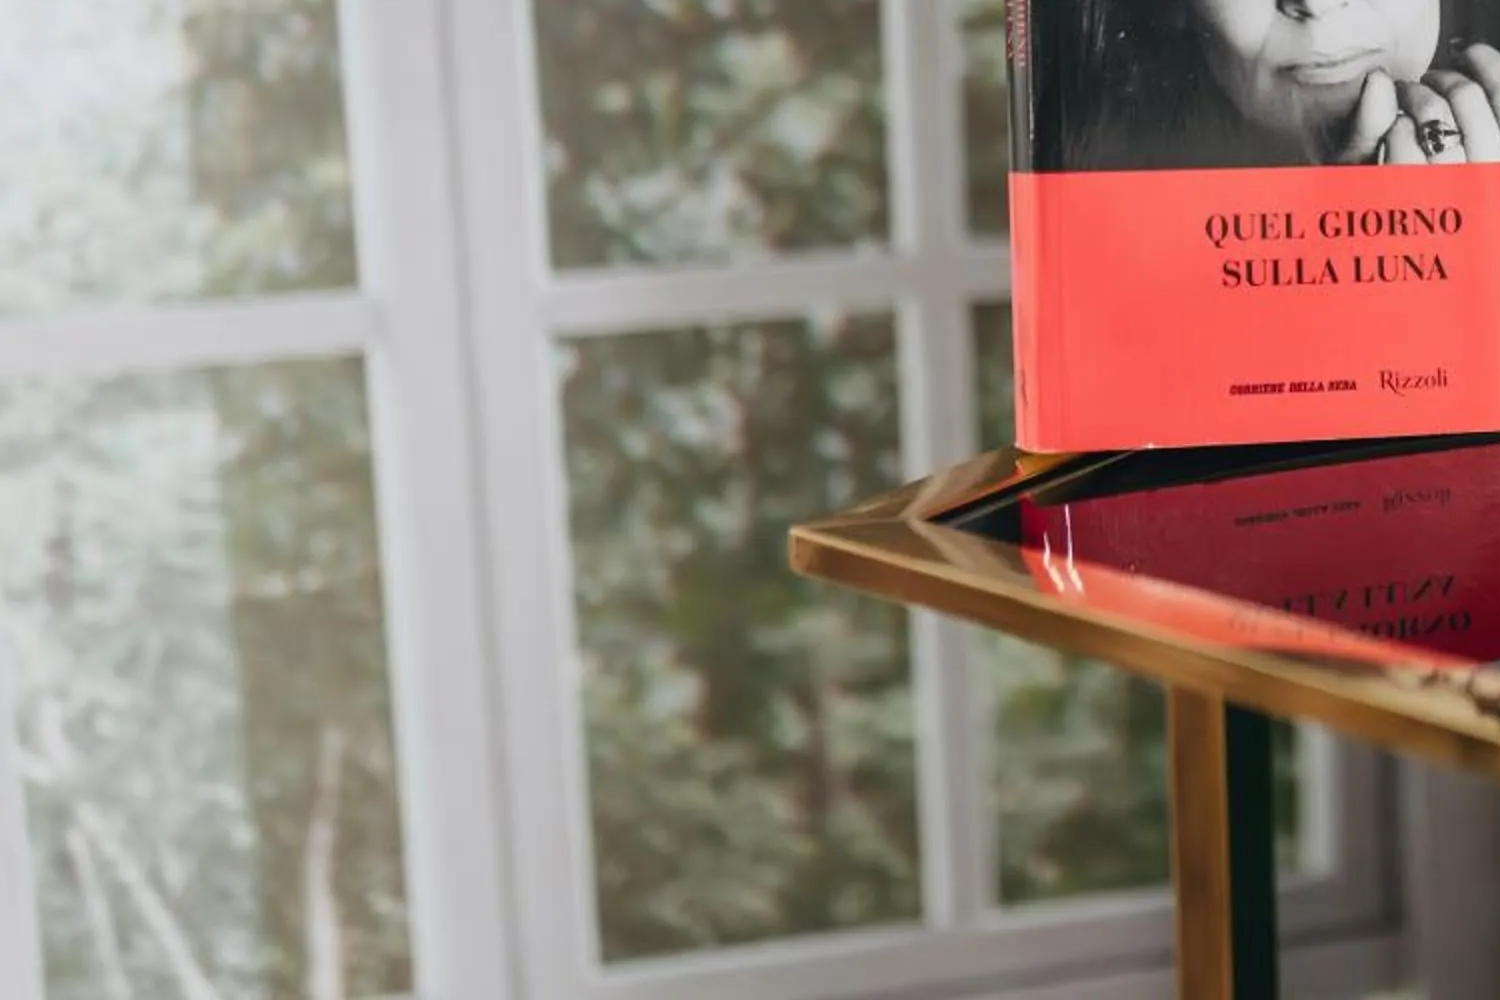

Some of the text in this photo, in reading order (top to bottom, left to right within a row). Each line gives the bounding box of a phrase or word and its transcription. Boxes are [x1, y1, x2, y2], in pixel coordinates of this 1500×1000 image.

[1205, 207, 1463, 248] QUEL GIORNO
[1221, 254, 1449, 288] SULLA LUNA
[1289, 380, 1325, 394] DELLA
[1379, 368, 1448, 397] Rizzoli
